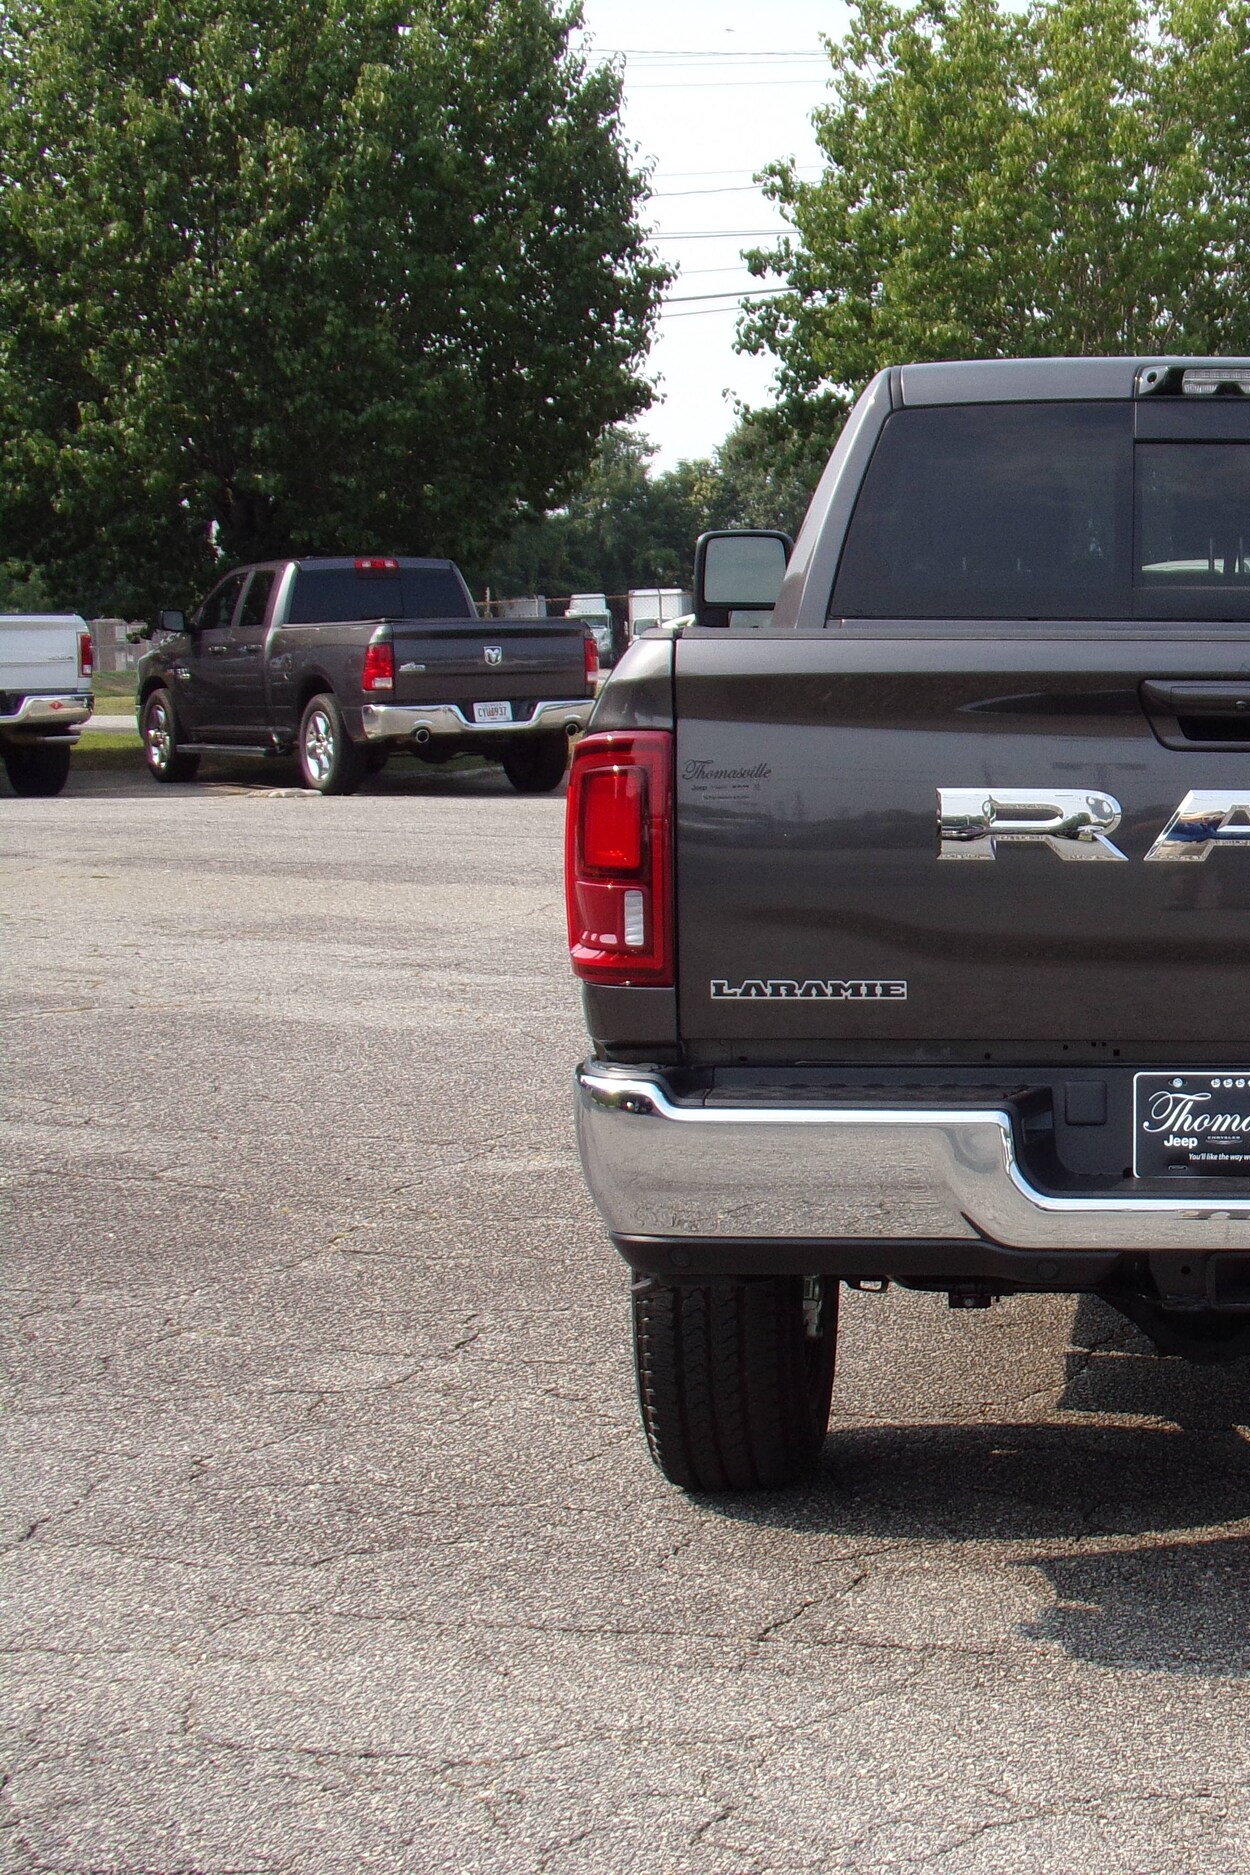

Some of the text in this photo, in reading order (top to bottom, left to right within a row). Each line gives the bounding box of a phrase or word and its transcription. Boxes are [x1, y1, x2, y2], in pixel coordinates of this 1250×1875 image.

[682, 759, 771, 780] Thomasville
[710, 979, 908, 1000] LARAMIE
[1164, 1134, 1198, 1149] Jeep
[1188, 1152, 1206, 1160] You'll
[1206, 1152, 1218, 1160] like
[1218, 1152, 1229, 1160] the
[1229, 1154, 1243, 1162] way
